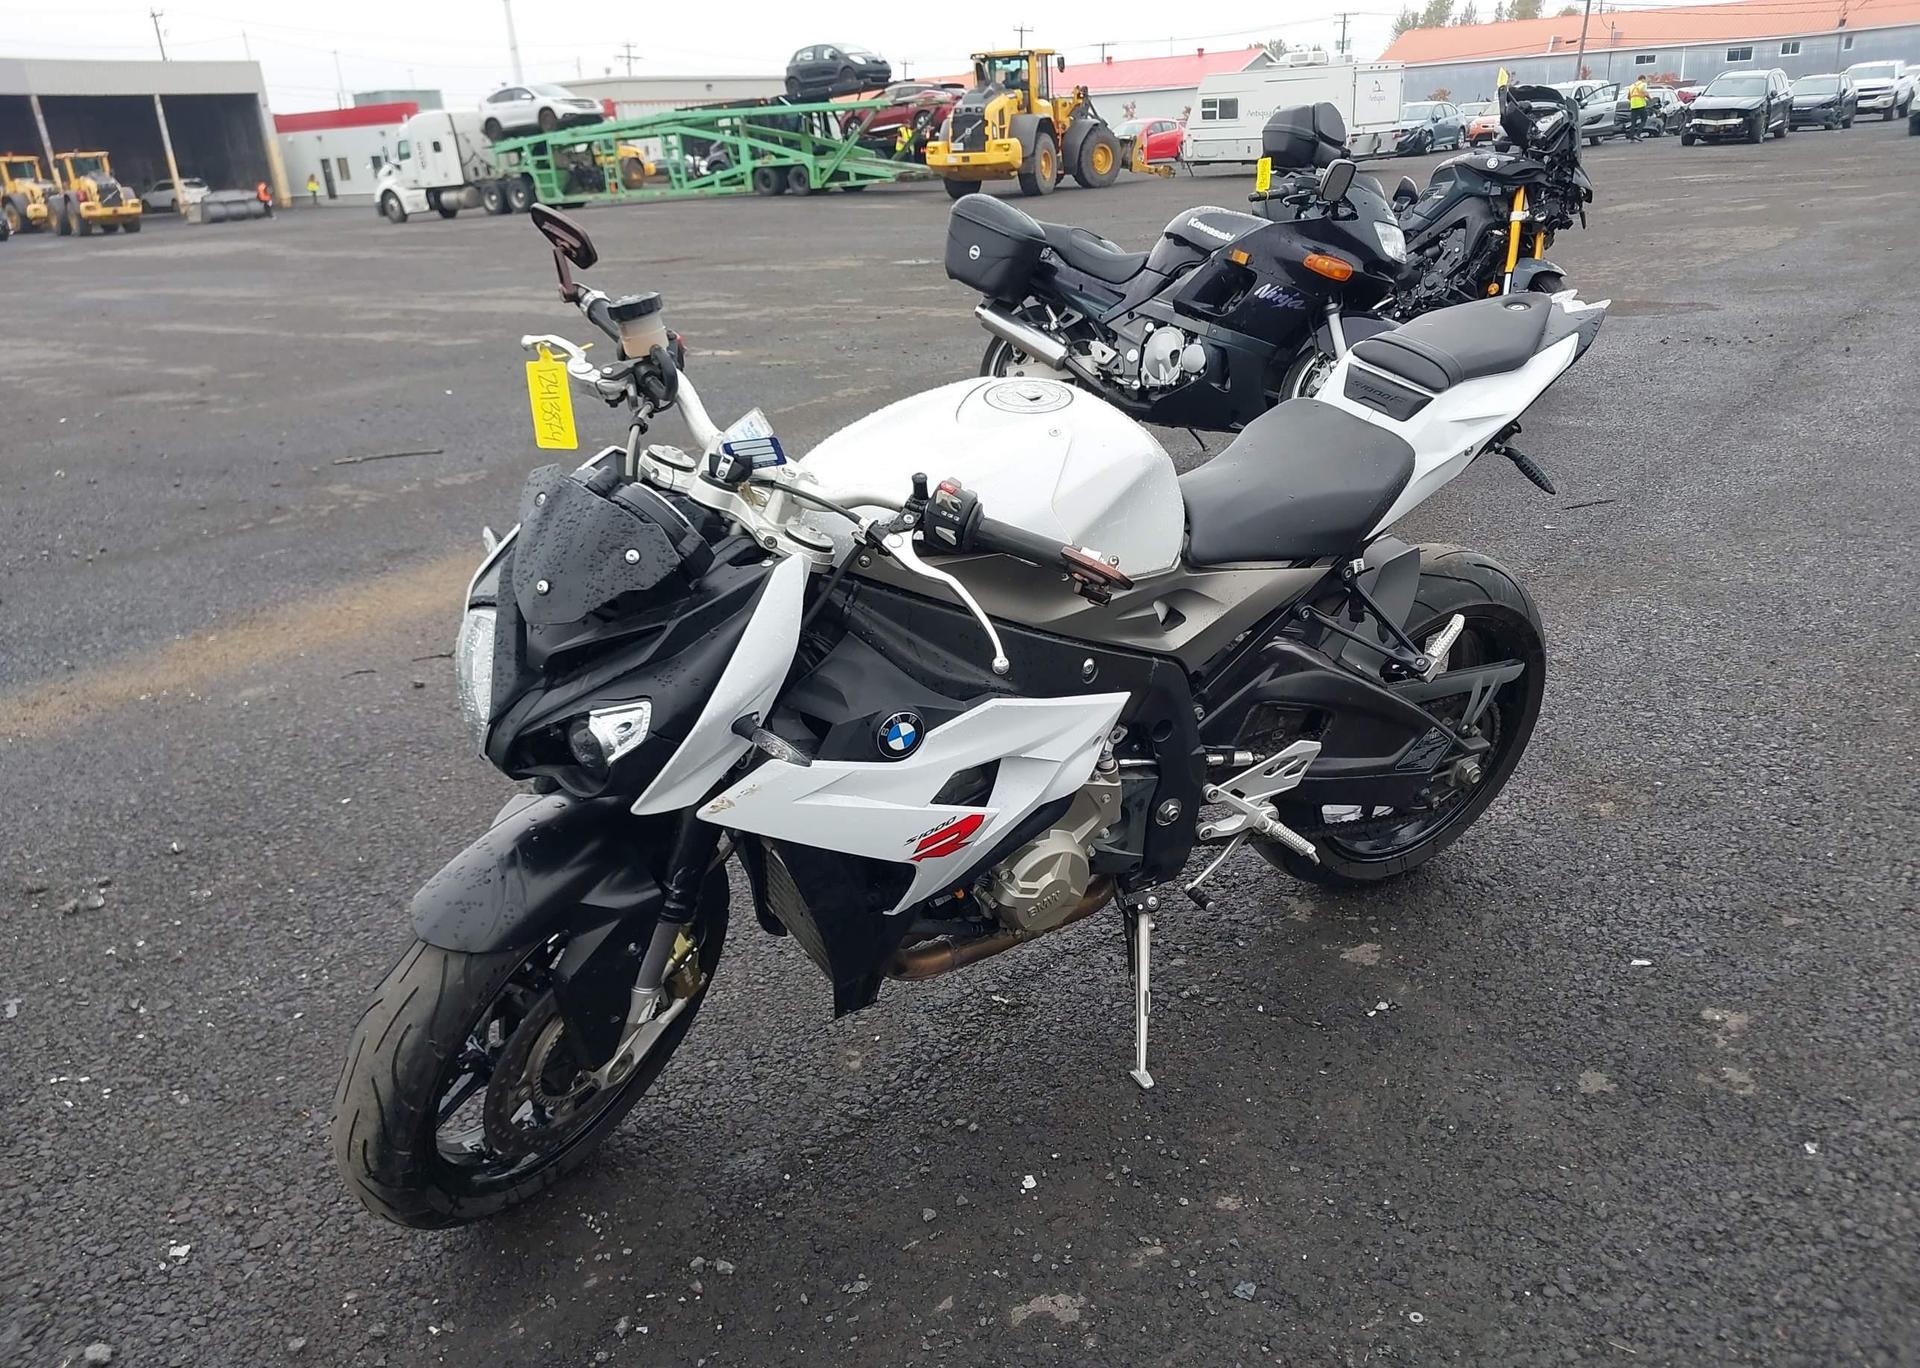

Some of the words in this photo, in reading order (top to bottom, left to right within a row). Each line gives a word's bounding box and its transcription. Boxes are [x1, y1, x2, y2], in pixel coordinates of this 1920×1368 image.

[1187, 216, 1236, 242] Kawasaki
[1253, 283, 1306, 310] Ninja
[880, 713, 918, 737] BMW
[903, 815, 957, 846] S1000
[1026, 889, 1061, 918] BMW
